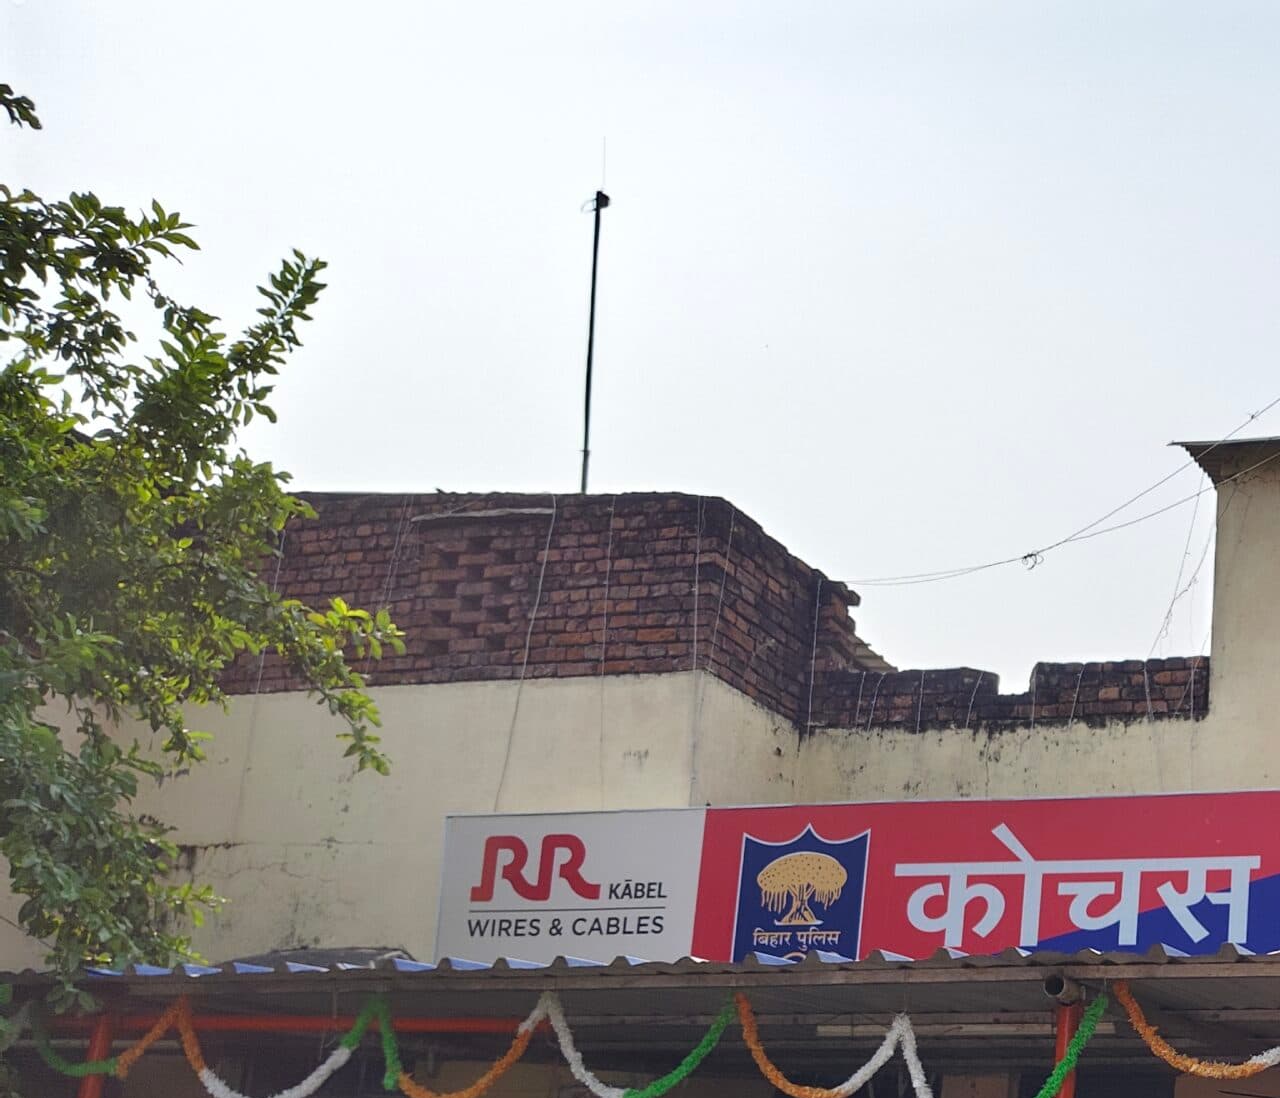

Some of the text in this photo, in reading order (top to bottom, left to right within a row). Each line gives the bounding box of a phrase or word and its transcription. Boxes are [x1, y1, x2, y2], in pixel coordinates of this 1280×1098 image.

[470, 833, 601, 901] RR
[609, 879, 668, 900] KĀBEL
[895, 822, 1260, 949] कोचस
[467, 915, 665, 937] WIRES & CABLES
[752, 926, 841, 951] बिहार पुलिस
